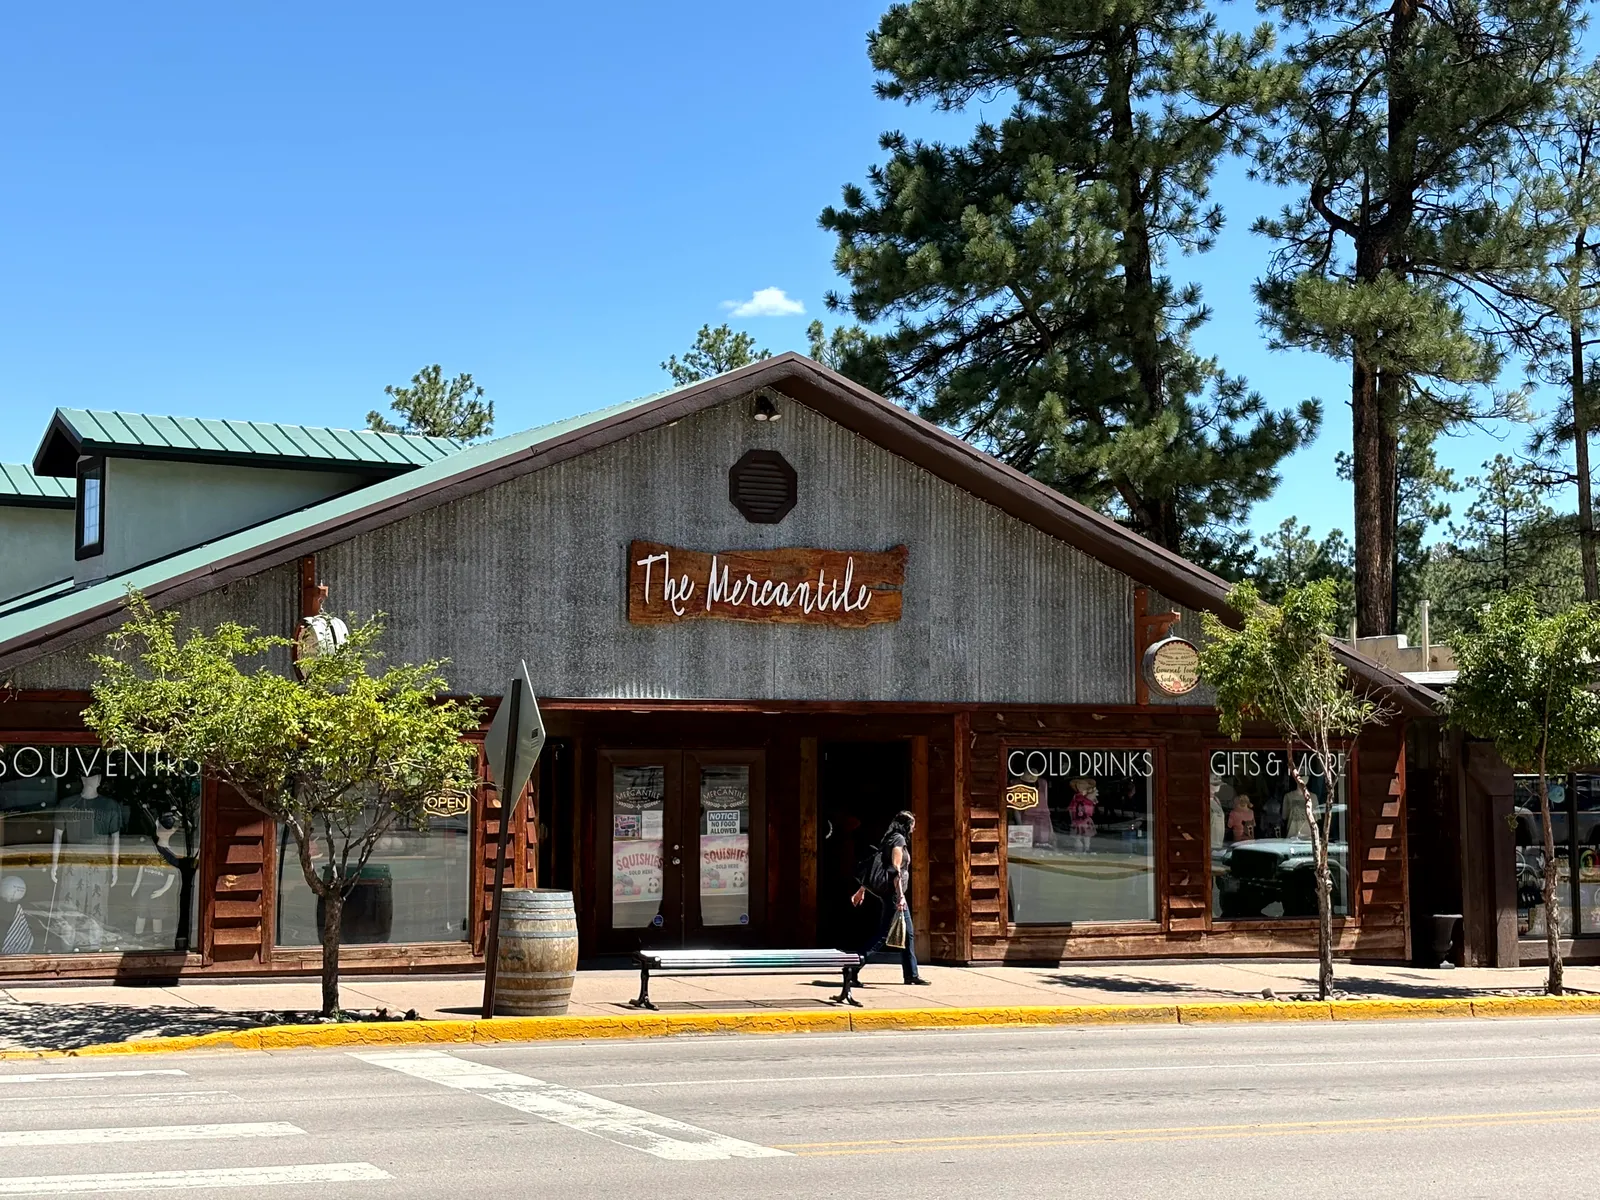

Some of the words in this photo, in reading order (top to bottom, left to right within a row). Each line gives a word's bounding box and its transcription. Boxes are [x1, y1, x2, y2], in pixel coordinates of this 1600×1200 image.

[637, 551, 694, 616] The
[706, 555, 873, 614] Mercantile
[1008, 750, 1071, 777] COLD
[1079, 751, 1154, 777] DRINKS
[1210, 751, 1261, 776] GIFTS
[1266, 752, 1282, 776] &
[615, 789, 661, 800] MERCANTILE
[702, 789, 747, 799] MERCANTILE
[1006, 792, 1036, 803] OPEN
[427, 797, 466, 808] OPEN
[616, 852, 664, 871] SQUISHIES
[703, 848, 749, 864] SQUISHIES
